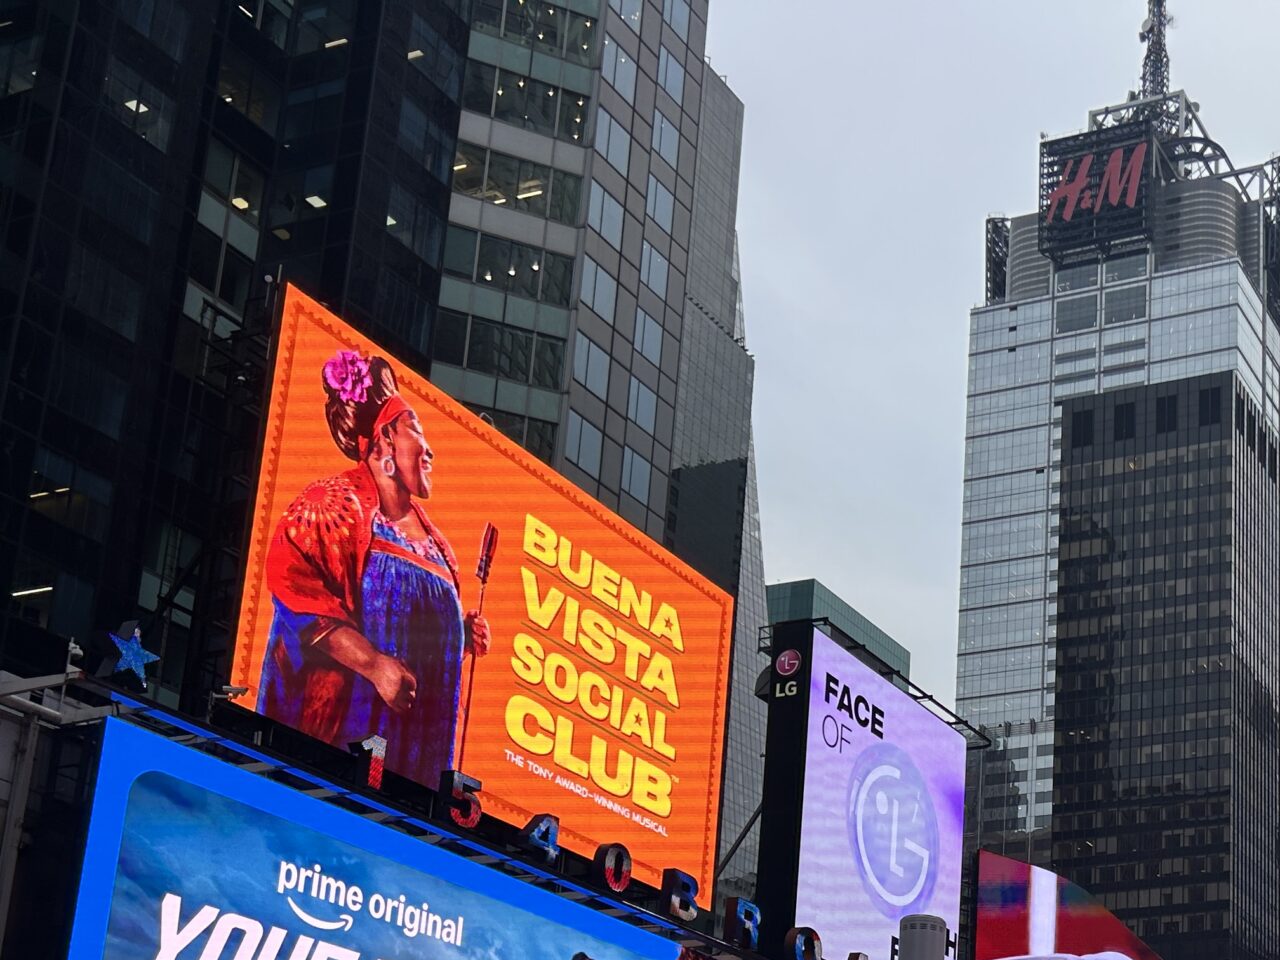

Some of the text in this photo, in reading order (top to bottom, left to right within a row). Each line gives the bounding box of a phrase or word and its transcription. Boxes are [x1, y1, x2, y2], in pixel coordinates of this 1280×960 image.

[1047, 142, 1148, 225] H&M
[523, 513, 685, 653] BUENA
[520, 566, 680, 709] VISTA
[511, 632, 677, 762] SOCIAL
[775, 681, 797, 698] LG
[824, 672, 885, 740] FACE
[504, 694, 672, 819] CLUB
[822, 714, 853, 754] OF
[504, 749, 669, 837] THE TONY AWARD-WINNING MUSICAL
[277, 861, 464, 947] prime original
